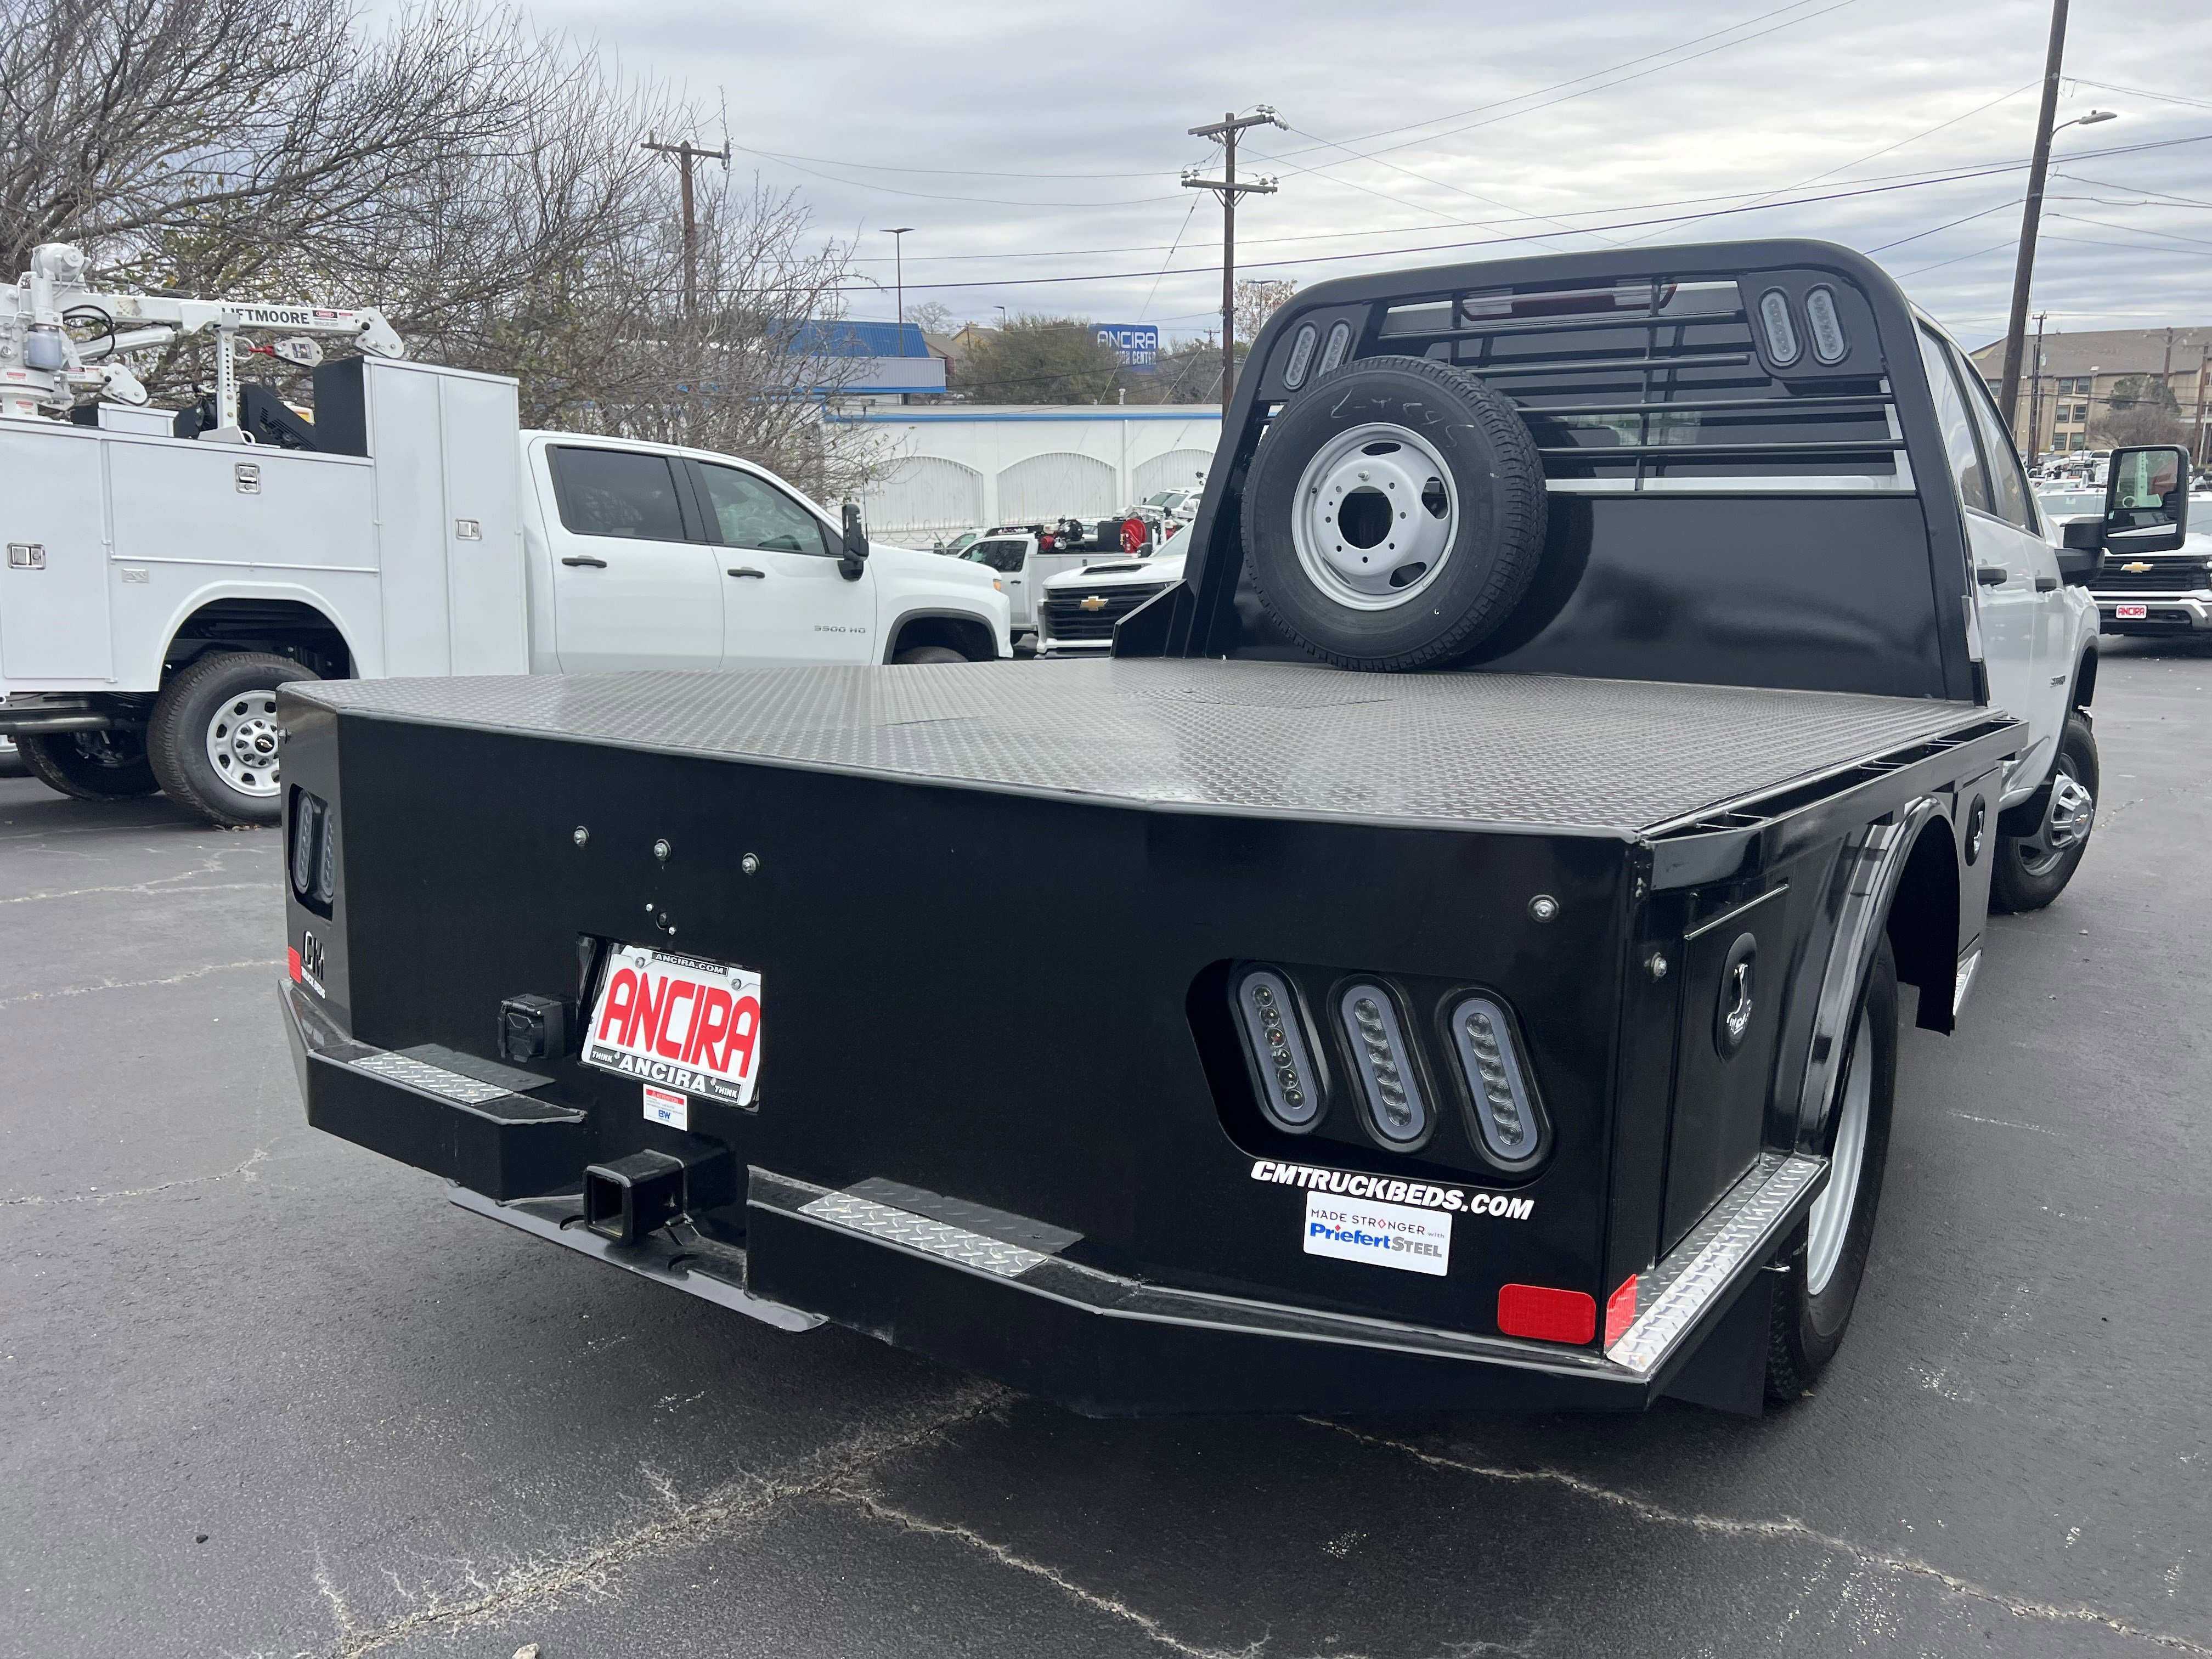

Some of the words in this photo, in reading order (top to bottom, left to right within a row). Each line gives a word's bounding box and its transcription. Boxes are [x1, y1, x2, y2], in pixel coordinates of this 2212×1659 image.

[1097, 330, 1156, 349] ANCIRA
[2118, 607, 2145, 616] ANCIRA
[655, 953, 724, 974] ANCIRA.COM
[598, 968, 761, 1078] ANCIRA
[592, 1050, 613, 1063] THINK
[618, 1054, 706, 1093] ANCIRA
[714, 1085, 738, 1098] THINK
[1250, 1160, 1534, 1221] CMTRUCKBEDS.COM
[1311, 1209, 1347, 1222] MADE
[1351, 1215, 1425, 1235] STRONGER
